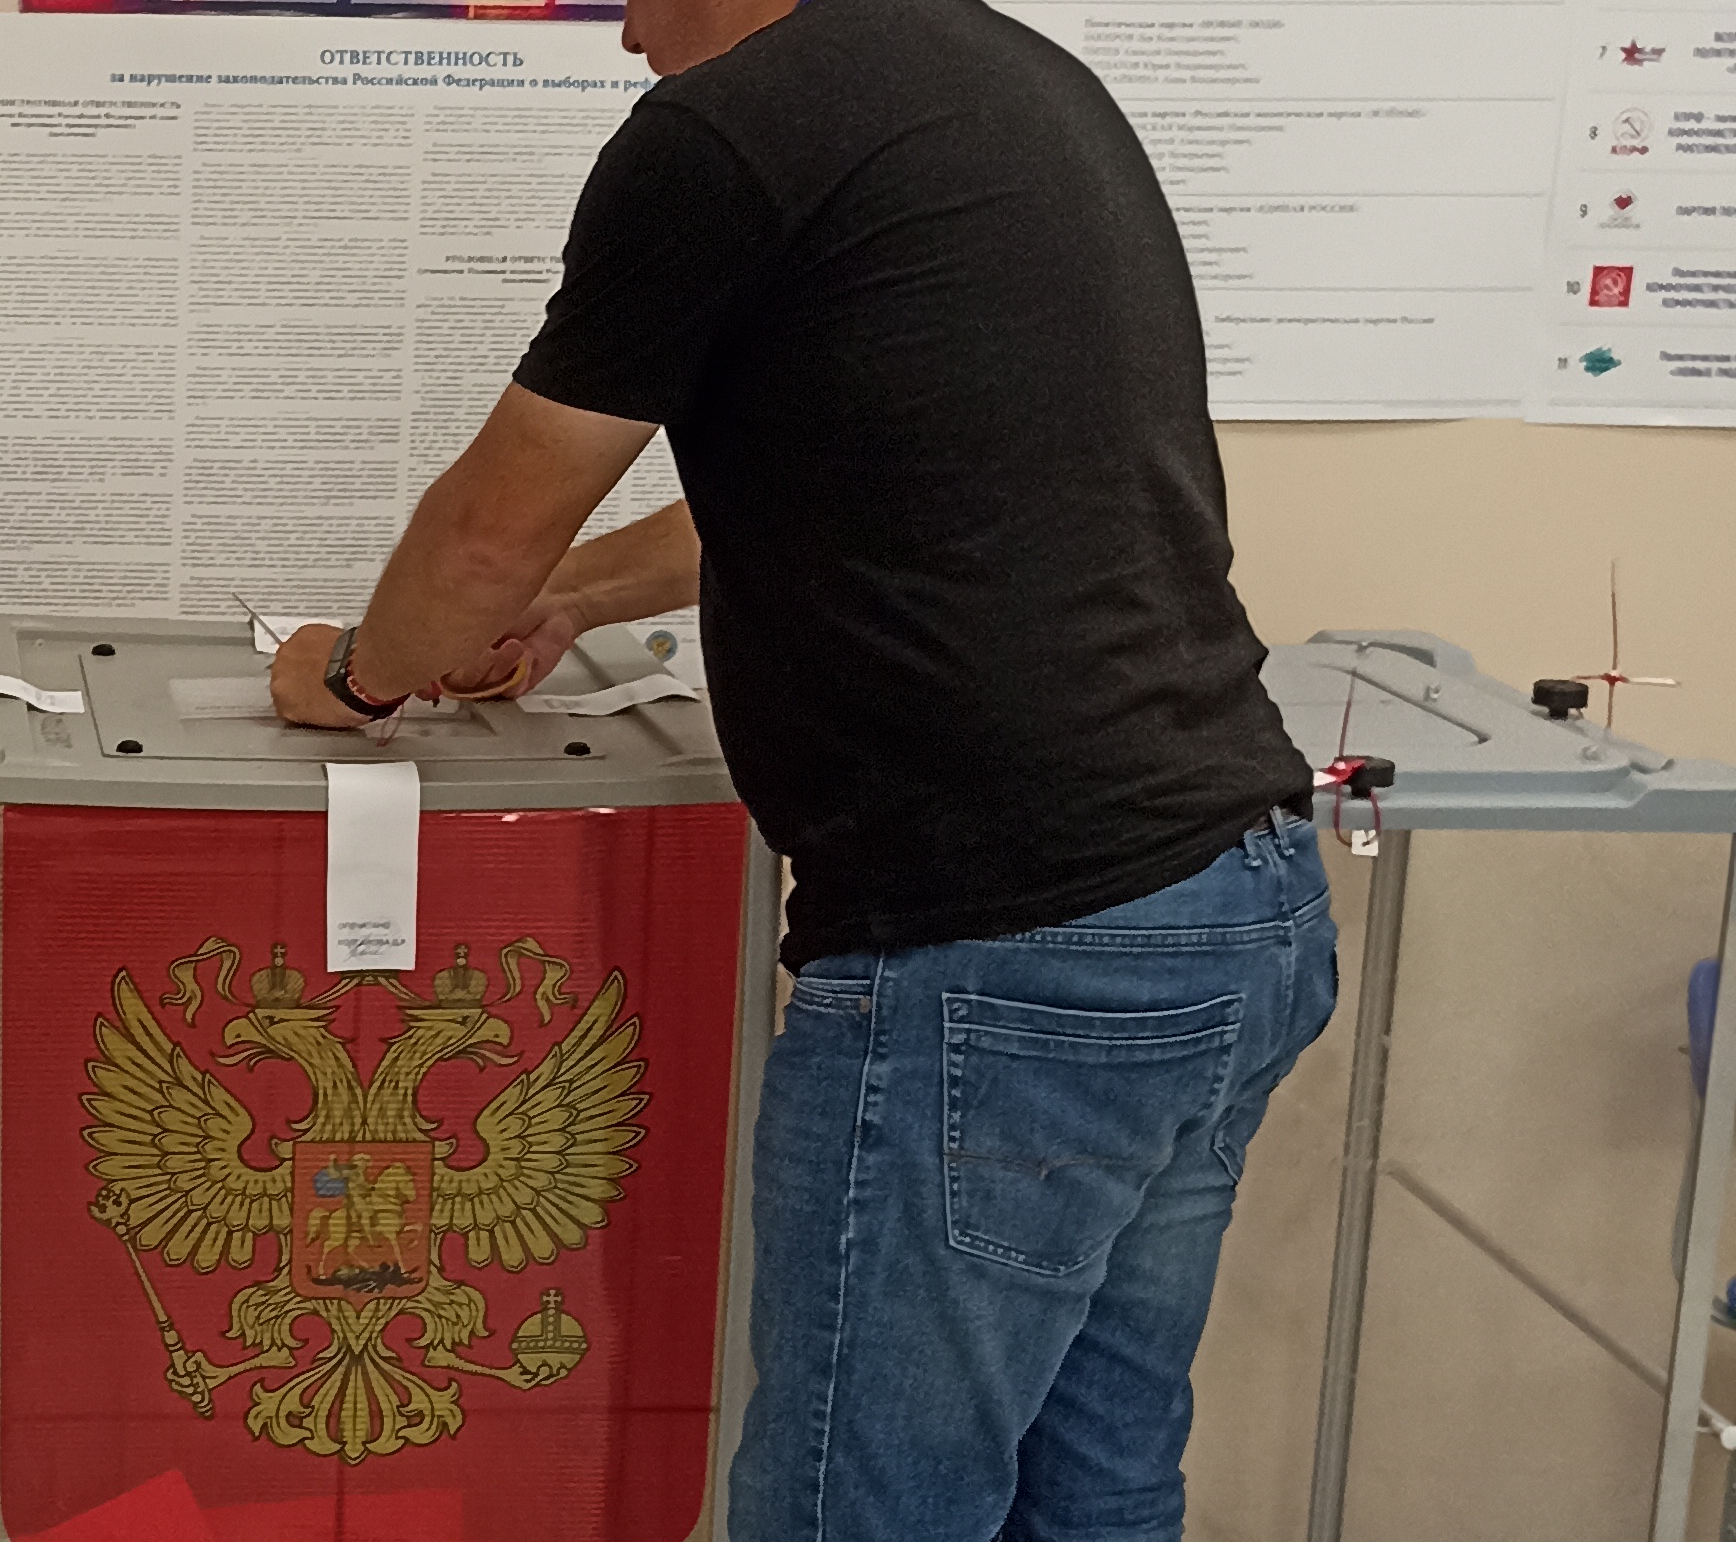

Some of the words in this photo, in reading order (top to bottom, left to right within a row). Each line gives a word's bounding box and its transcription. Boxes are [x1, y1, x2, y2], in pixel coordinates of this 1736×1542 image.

[319, 49, 525, 68] ОТВЕТСТВЕННОСТЬ
[129, 72, 213, 87] нарушение
[216, 73, 348, 86] законодательства
[352, 72, 438, 88] Российской
[442, 73, 525, 91] Федерации
[542, 76, 606, 92] выборах
